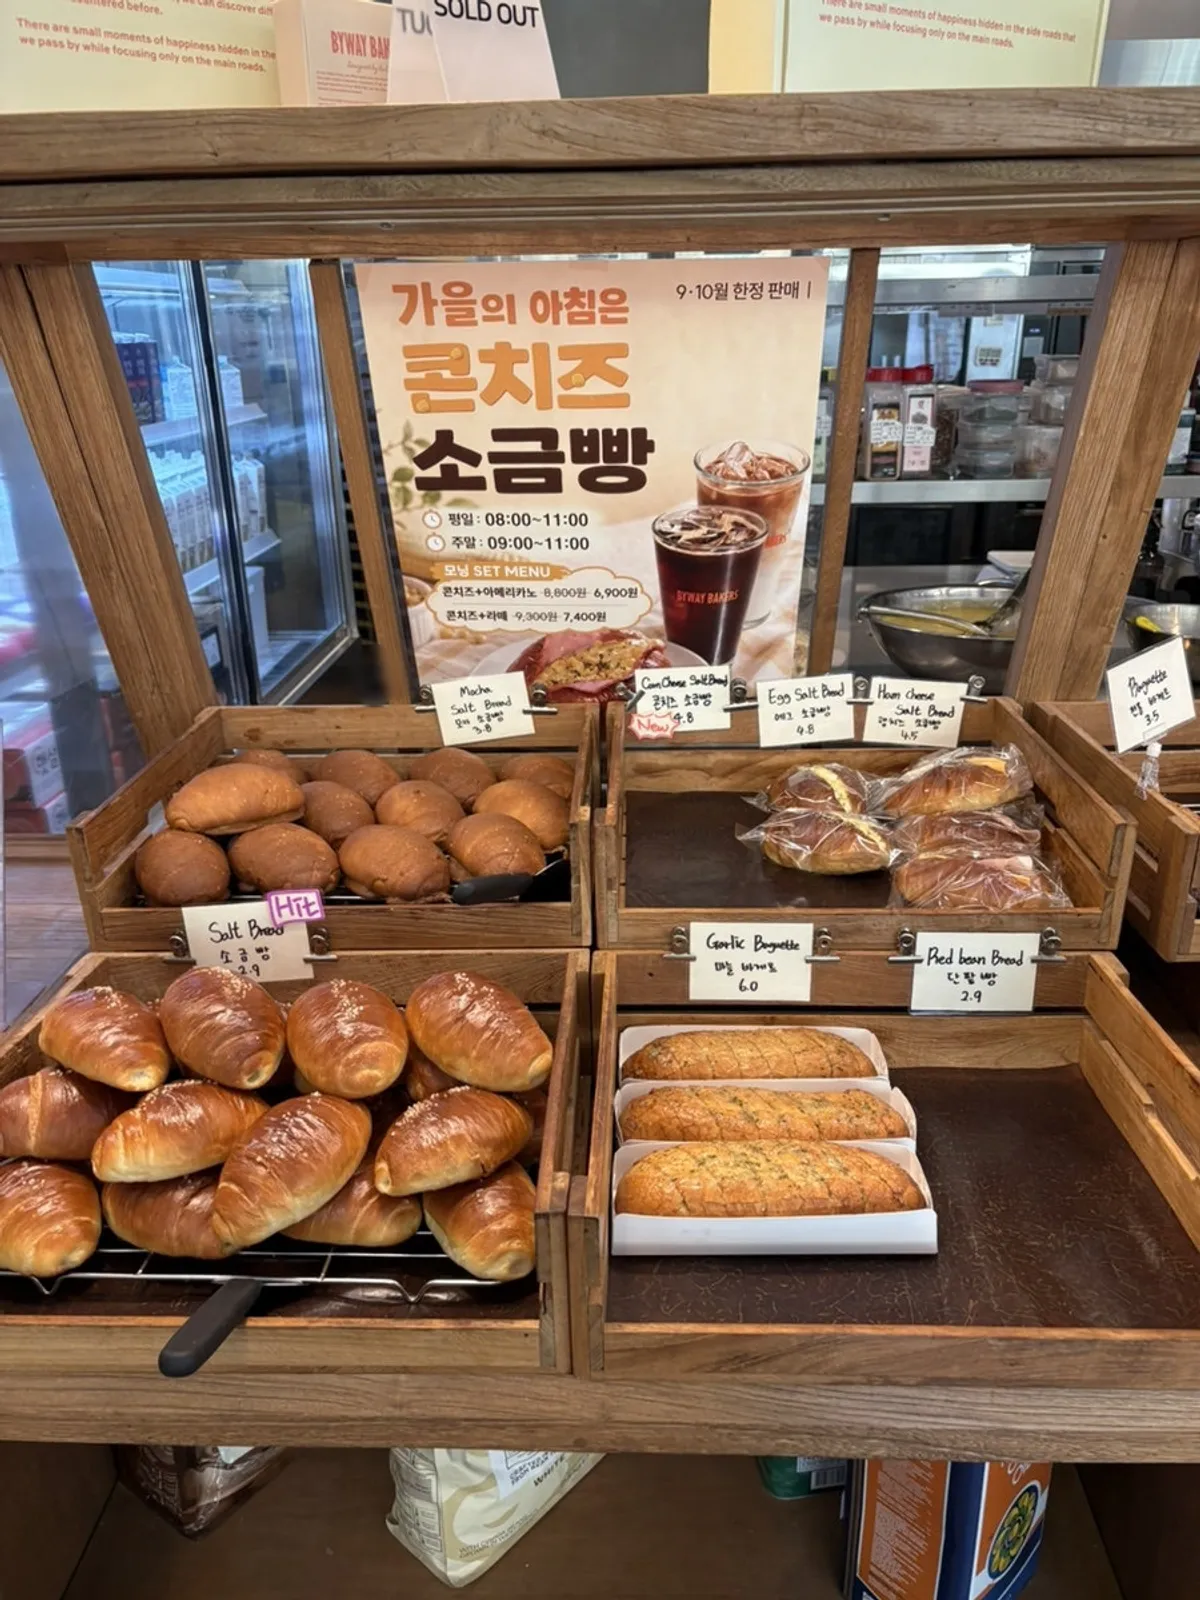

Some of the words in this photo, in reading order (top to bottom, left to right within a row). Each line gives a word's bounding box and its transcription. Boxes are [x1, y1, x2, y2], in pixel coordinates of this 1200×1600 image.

[435, 0, 491, 22] SOLD
[497, 3, 539, 28] OUT
[849, 0, 863, 10] are
[865, 2, 887, 13] small
[889, 6, 926, 19] moments
[928, 9, 937, 21] of
[938, 11, 977, 28] happiness
[979, 17, 1003, 31] hidden
[1013, 23, 1025, 34] the
[1026, 25, 1041, 37] side
[1042, 28, 1061, 41] roads
[1062, 30, 1076, 43] that
[16, 17, 50, 32] There
[52, 23, 70, 34] are
[72, 25, 101, 38] small
[103, 30, 152, 45] moments
[154, 35, 164, 46] of
[166, 36, 215, 53] happiness
[218, 42, 250, 57] hidden
[251, 47, 260, 58] in
[261, 48, 276, 60] the
[819, 13, 832, 23] we
[834, 15, 855, 26] pass
[857, 17, 867, 29] by
[870, 19, 890, 31] while
[892, 21, 927, 38] focusing
[928, 26, 945, 40] only
[946, 30, 956, 39] on
[957, 30, 970, 41] the
[972, 34, 990, 44] main
[331, 30, 367, 57] BYWAY
[19, 36, 35, 46] we
[38, 38, 65, 50] pass
[67, 39, 80, 53] by
[82, 42, 110, 55] while
[112, 44, 157, 63] focusing
[159, 50, 180, 64] only
[182, 54, 194, 64] on
[195, 55, 212, 67] the
[214, 58, 236, 70] main
[238, 60, 267, 73] roads.
[676, 282, 729, 301] 9·10월
[733, 281, 764, 300] 한정
[768, 281, 800, 300] 판매
[392, 281, 516, 327] 가을의
[529, 287, 630, 326] 아침은
[402, 341, 632, 414] 콘치즈
[412, 427, 655, 495] 소금빵
[448, 513, 474, 527] 평일
[485, 512, 589, 527] 08:00~11:00
[452, 536, 476, 550] 주말
[487, 536, 590, 550] 09:00~11:00
[443, 563, 470, 578] 모닝
[473, 565, 501, 578] SET
[504, 565, 550, 578] MENU
[442, 586, 538, 599] 콘치즈+아메리카노
[543, 587, 588, 599] 8,800원
[593, 587, 639, 599] 6,900원
[677, 590, 706, 604] BYWAY
[707, 589, 739, 604] BAKERS
[563, 611, 607, 623] 7,400원
[459, 684, 493, 698] Mocha
[878, 683, 901, 700] Ham
[1128, 669, 1168, 698] Baguette
[768, 687, 791, 706] Egg
[794, 686, 819, 702] Salt
[821, 682, 845, 699] Bread
[450, 702, 477, 716] Salt
[484, 695, 513, 711] Bread
[895, 704, 921, 717] Salt
[928, 703, 955, 718] Bread
[637, 718, 669, 732] New
[673, 711, 695, 724] 4.8
[472, 723, 493, 735] 3.8
[796, 723, 815, 736] 4.8
[901, 729, 919, 741] 4.5
[274, 896, 319, 919] Hit
[208, 921, 243, 944] Salt
[706, 932, 746, 951] Garlic
[754, 934, 800, 954] Baguette
[926, 946, 954, 967] Red
[958, 947, 986, 966] bean
[991, 949, 1024, 967] Bread
[738, 977, 759, 992] 6.0
[960, 990, 982, 1003] 2.9
